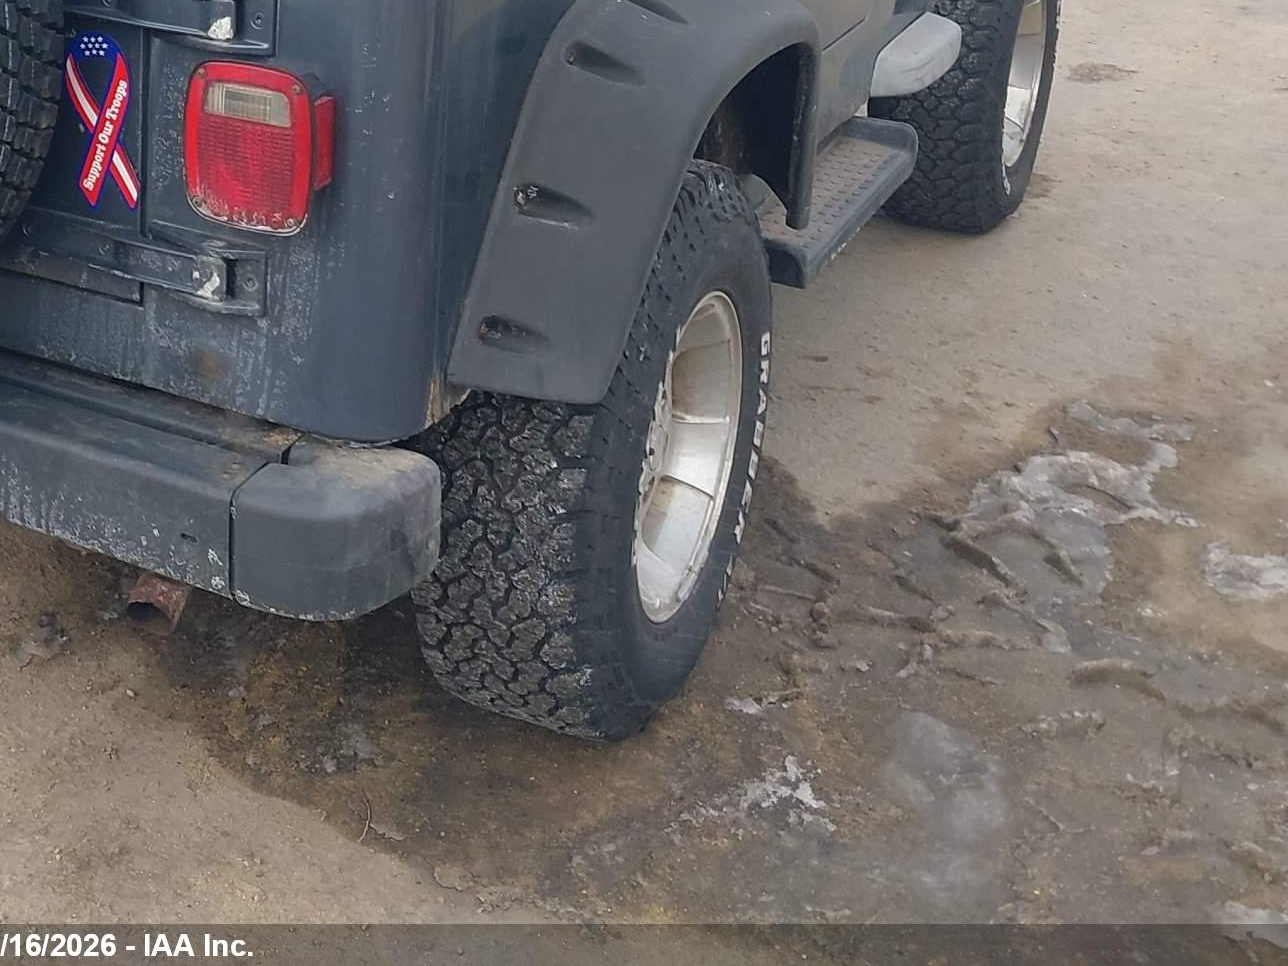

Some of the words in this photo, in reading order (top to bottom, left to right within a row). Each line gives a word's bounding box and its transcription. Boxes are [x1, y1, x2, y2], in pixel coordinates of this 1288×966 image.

[104, 79, 128, 122] Troops
[97, 121, 115, 145] Our
[82, 142, 108, 192] Support
